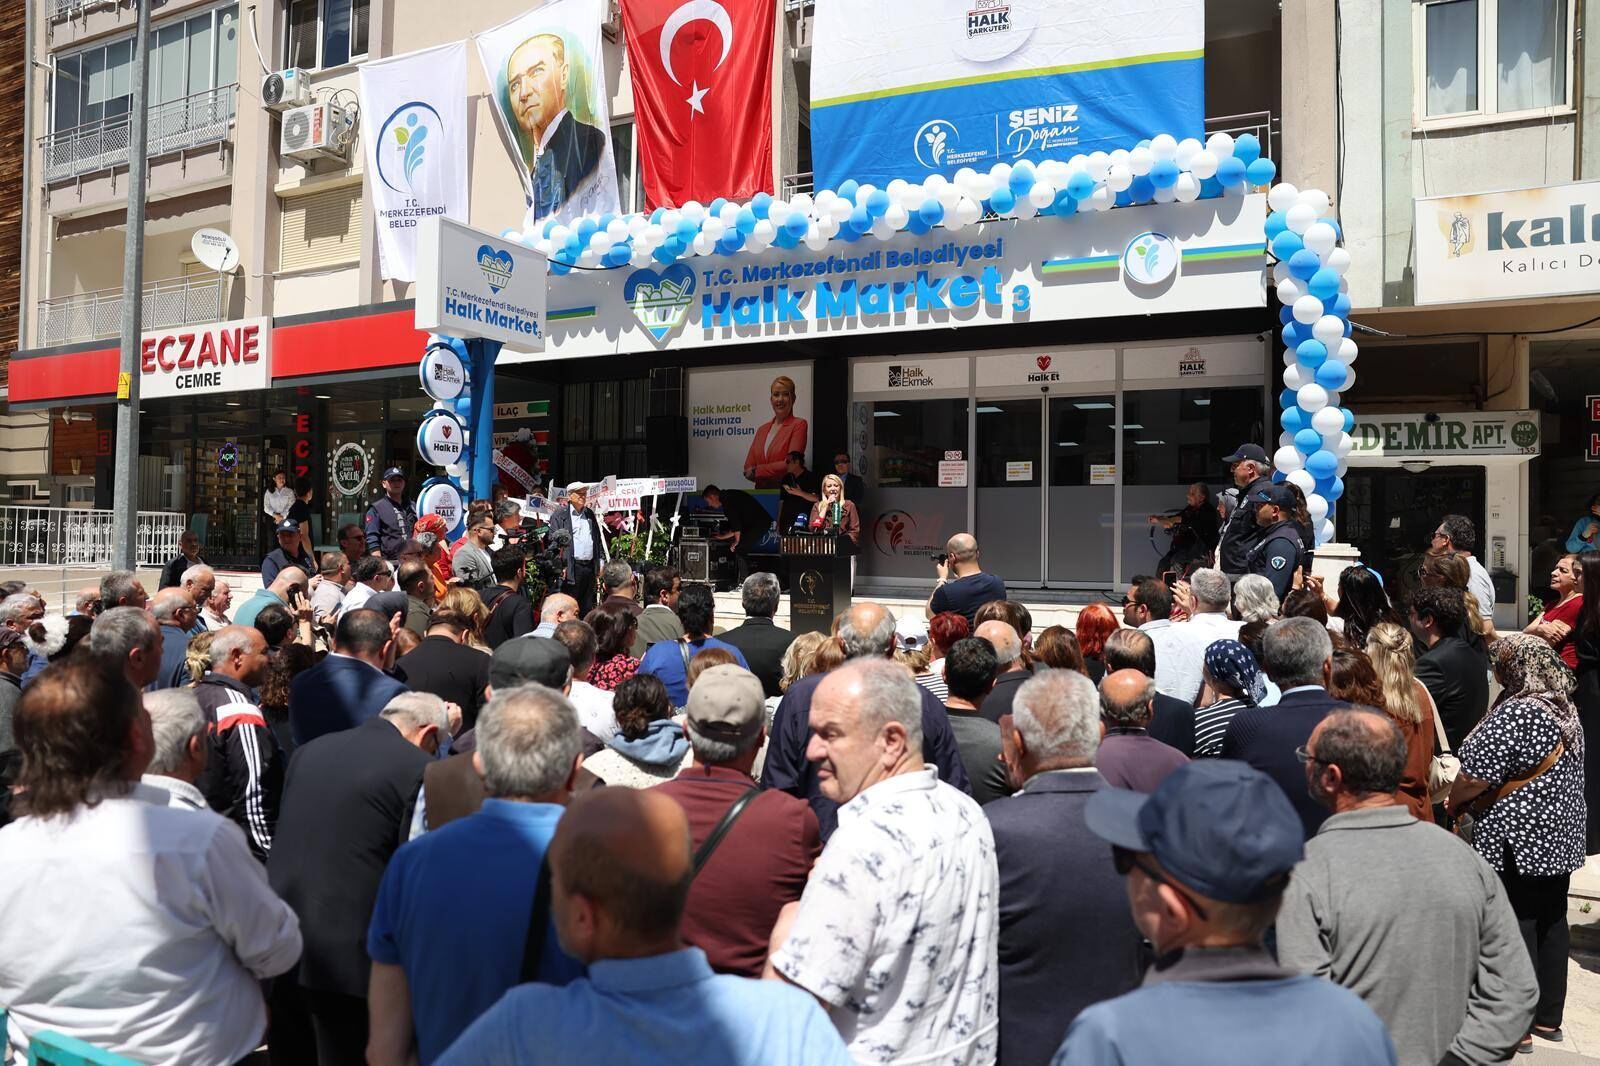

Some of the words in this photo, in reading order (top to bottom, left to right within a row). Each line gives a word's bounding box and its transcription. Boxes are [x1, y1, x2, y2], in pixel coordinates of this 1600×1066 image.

[969, 12, 1008, 28] HALK
[1006, 125, 1079, 158] Doğan
[379, 204, 447, 218] MERKEZEFENDİ
[389, 219, 417, 229] BELED
[1487, 203, 1600, 252] kal
[703, 270, 738, 288] T.C.
[742, 252, 880, 284] Merkezefendi
[885, 238, 1003, 271] Belediyesi
[1502, 257, 1567, 273] Kalıcı
[1579, 254, 1600, 268] D
[702, 284, 806, 329] Halk
[816, 264, 1003, 319] Market
[1012, 284, 1031, 312] 3
[461, 291, 506, 310] Merkezefendi
[507, 302, 539, 319] Belediyesi
[445, 297, 482, 322] Halk
[485, 308, 538, 336] Market
[141, 325, 259, 373] ECZANE
[902, 367, 924, 378] Halk
[1180, 363, 1205, 371] HALK
[175, 371, 222, 389] CEMRE
[902, 376, 934, 387] Ekmek
[1028, 373, 1050, 382] Halk
[1050, 373, 1060, 381] Et
[693, 404, 715, 415] Halk
[716, 403, 752, 414] Market
[693, 416, 742, 427] Halkımıza
[693, 427, 724, 440] Hayırlı
[726, 426, 755, 436] Olsun
[1472, 425, 1507, 445] APT.
[433, 443, 451, 452] Halk
[451, 444, 459, 453] Et
[435, 509, 455, 517] HALK
